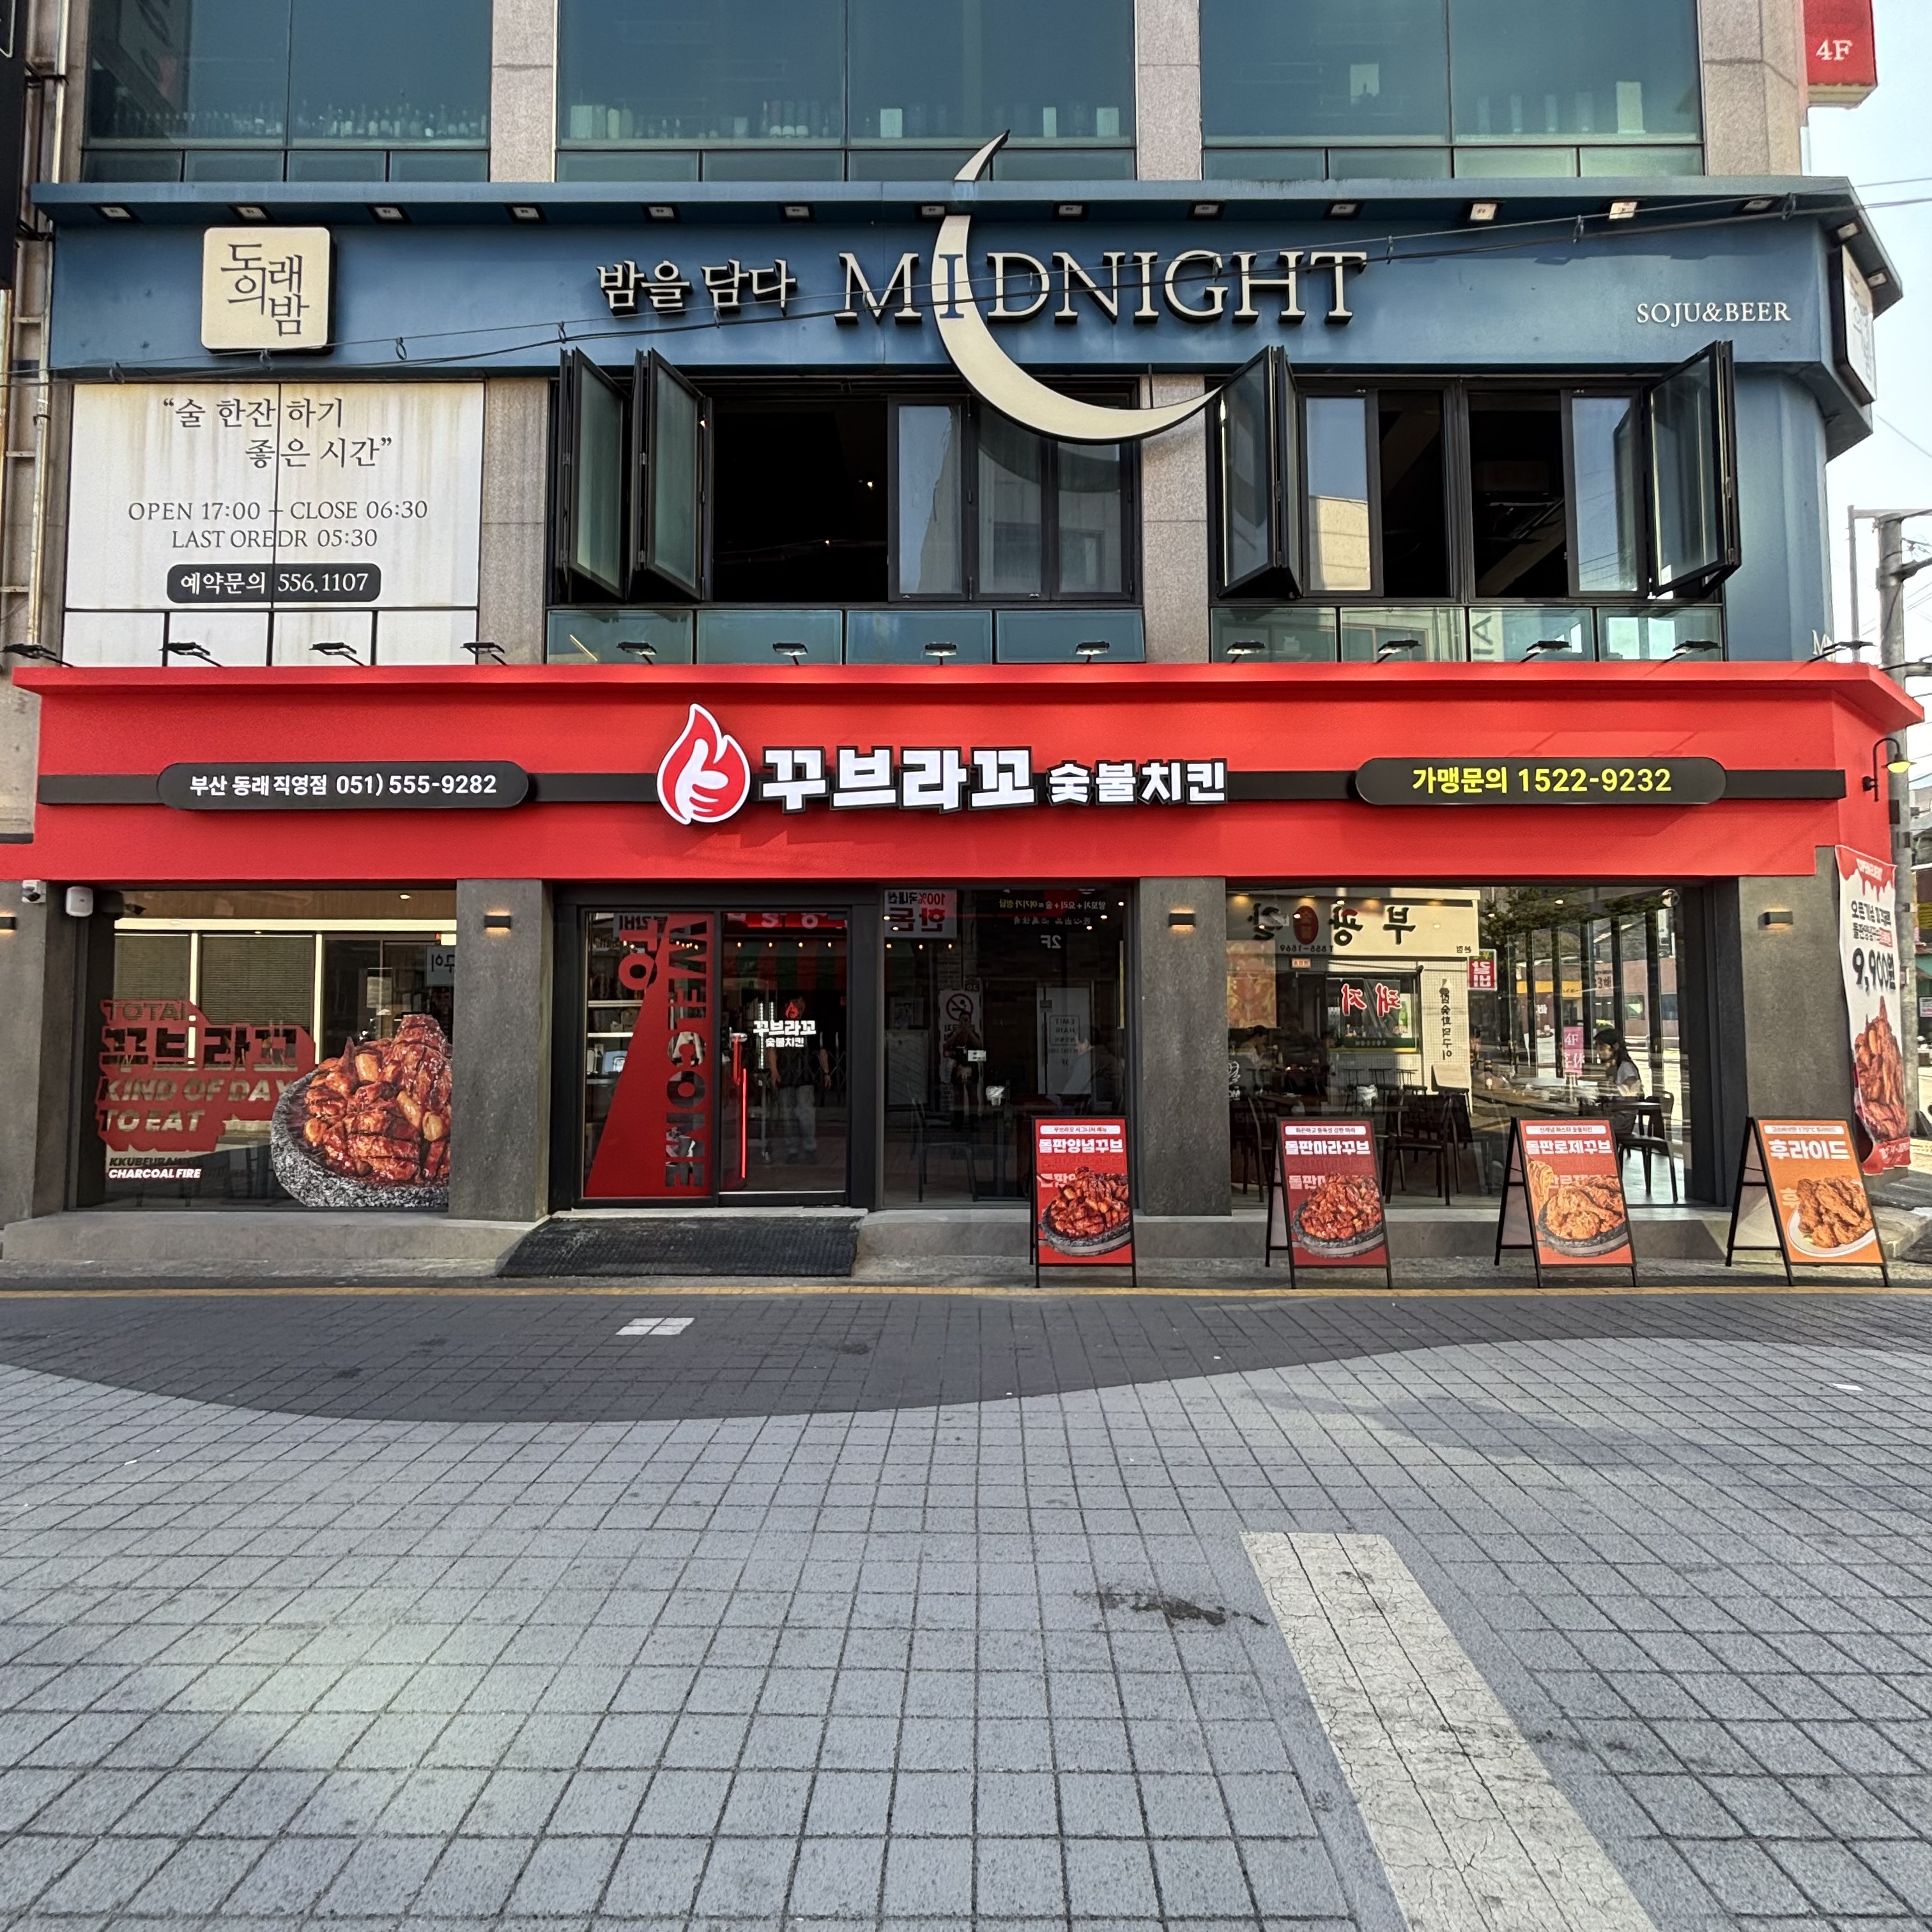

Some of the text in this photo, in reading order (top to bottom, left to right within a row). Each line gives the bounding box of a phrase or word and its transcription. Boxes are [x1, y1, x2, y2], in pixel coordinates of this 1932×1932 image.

[1816, 40, 1851, 61] 4F
[597, 258, 797, 315] 밤을 담다
[834, 250, 1367, 326] MIDNIGHT
[1636, 302, 1791, 327] SOJU&BEER
[217, 398, 276, 429] 한잔
[286, 397, 344, 428] 하기
[245, 438, 311, 470] 좋은
[128, 502, 193, 521] OPEN
[201, 502, 261, 521] 17:00
[289, 501, 358, 520] CLOSE
[366, 501, 427, 519] 06:30
[172, 529, 378, 549] LAST OREDR 05:30
[180, 571, 369, 595] 예약문의 556.1107
[190, 774, 496, 796] 부산 동래 직영점 051) 555-9282
[760, 746, 1228, 811] 꾸브라꼬 숯불치킨
[1412, 767, 1672, 794] 가맹문의 1522-9232
[753, 1020, 817, 1037] 꾸브라꼬
[100, 1078, 177, 1101] KIND
[183, 1078, 224, 1101] OF
[100, 1110, 205, 1132] TO EAT
[1039, 1138, 1124, 1153] 돌판양념꾸브
[1285, 1140, 1370, 1155] 돌판마라꾸브
[1526, 1140, 1613, 1154] 돌판로제꾸브
[1768, 1139, 1851, 1160] 후라이드
[108, 1169, 201, 1179] CHARCOAL FIRE
